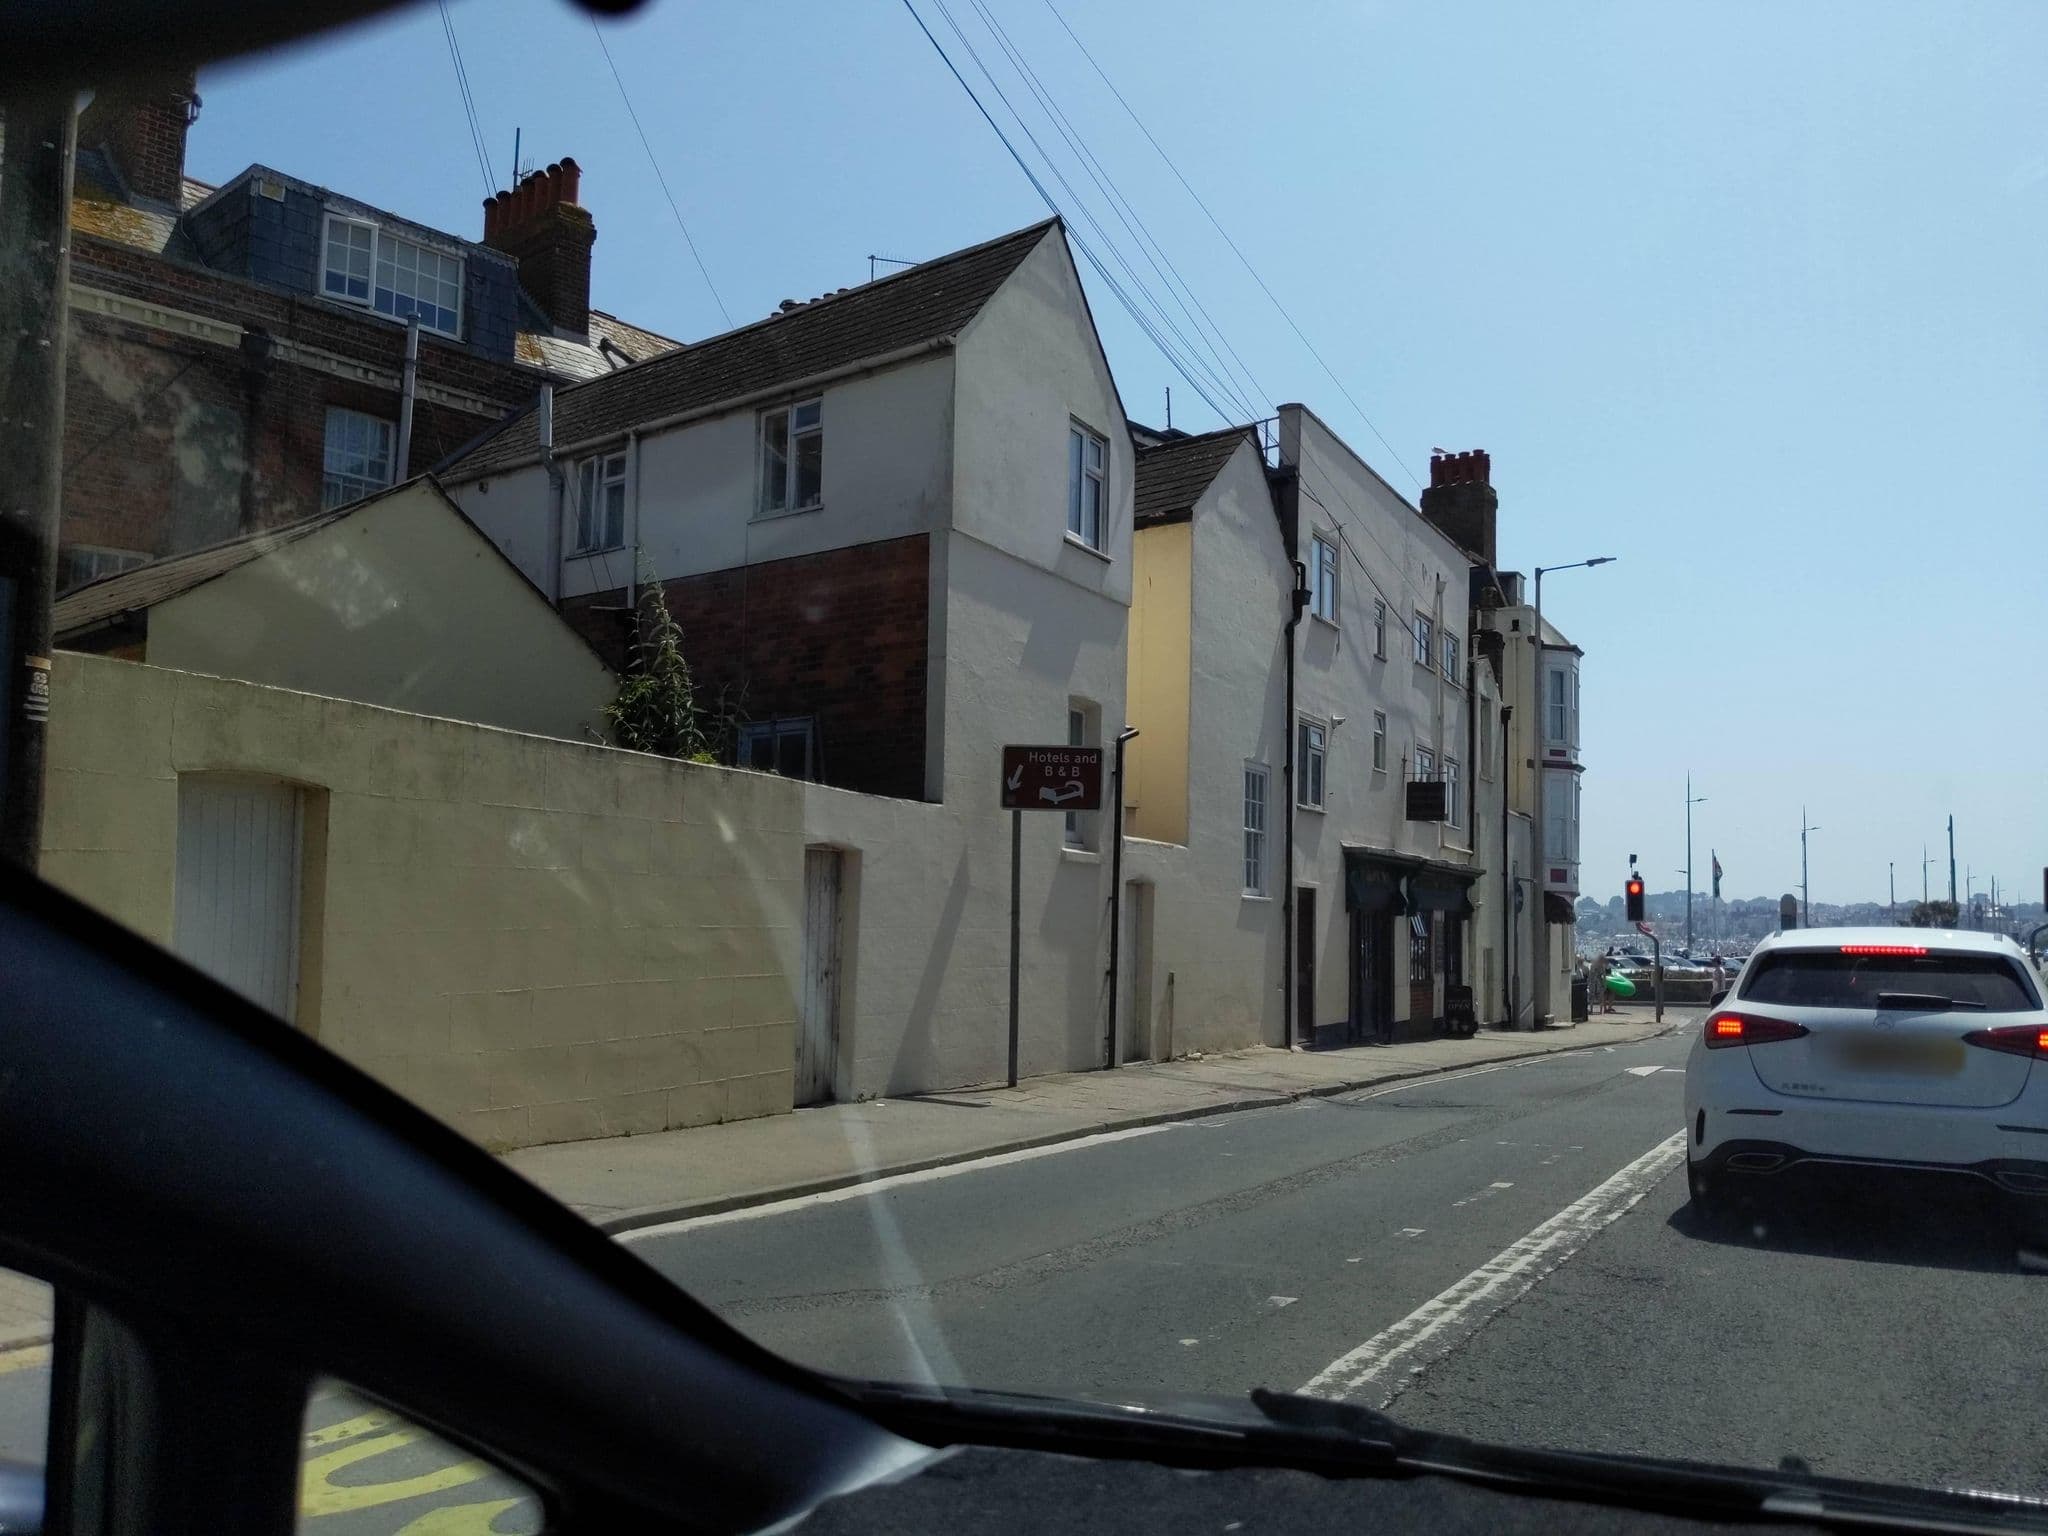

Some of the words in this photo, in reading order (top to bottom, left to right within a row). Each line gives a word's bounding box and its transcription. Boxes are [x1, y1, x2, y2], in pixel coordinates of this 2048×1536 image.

[1029, 752, 1070, 763] Hotels
[1074, 753, 1097, 764] and
[1045, 766, 1053, 776] B
[1058, 766, 1066, 776] &
[1072, 766, 1080, 777] B
